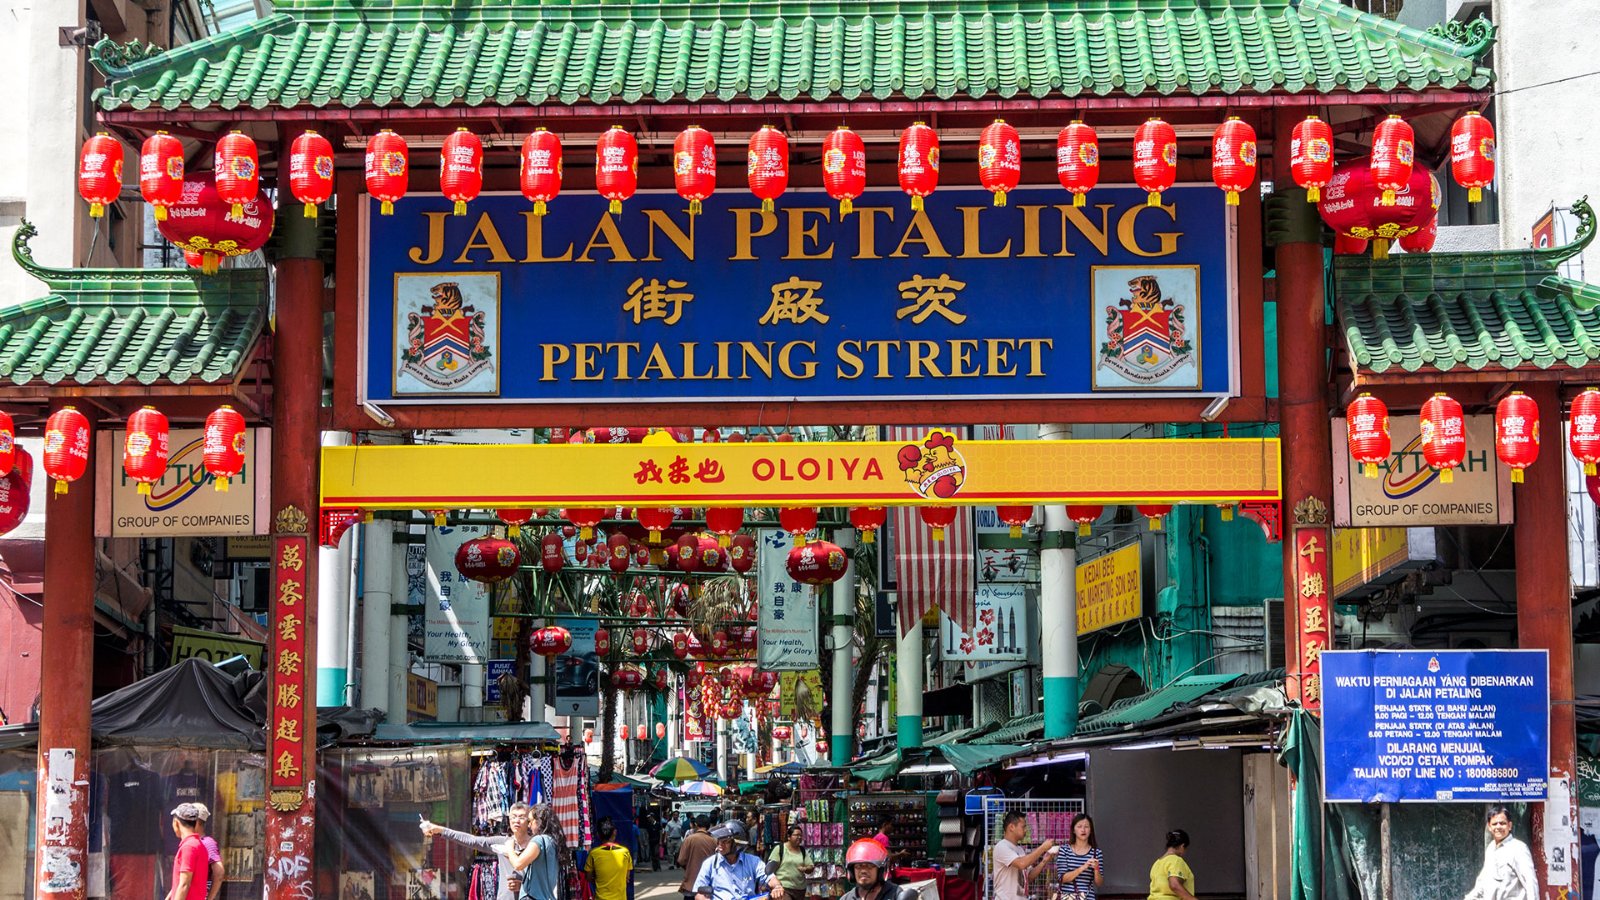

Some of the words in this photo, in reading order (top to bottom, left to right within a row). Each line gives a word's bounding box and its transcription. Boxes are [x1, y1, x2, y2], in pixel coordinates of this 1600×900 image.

[408, 208, 696, 264] JALAN
[728, 202, 1184, 260] PETALING
[539, 340, 819, 382] PETALING
[836, 338, 1053, 380] STREET
[752, 457, 884, 481] OLOIYA
[1356, 505, 1399, 516] GROUP
[1402, 504, 1418, 515] OF
[1422, 503, 1493, 515] COMPANIES
[118, 516, 159, 528] GROUP
[163, 516, 179, 527] OF
[181, 514, 250, 527] COMPANIES
[1102, 557, 1115, 577] BEG
[774, 582, 785, 620] 我自豪
[1336, 676, 1371, 687] WAKTU
[1374, 676, 1436, 687] PERNIAGAAN
[1441, 676, 1466, 687] YANG
[1471, 676, 1533, 687] DIBENARKAN
[1386, 688, 1396, 698] DI
[1400, 688, 1431, 698] JALAN
[1435, 688, 1482, 698] PETALING
[1387, 743, 1436, 753] DILARANG
[1441, 743, 1485, 753] MENJUAL
[1418, 755, 1449, 765] CETAK
[1454, 755, 1493, 765] ROMPAK
[1354, 768, 1387, 778] TALIAN
[1392, 768, 1410, 778] HOT
[1416, 768, 1436, 778] LINE
[1440, 768, 1455, 778] NO
[1466, 768, 1518, 778] 1800886800
